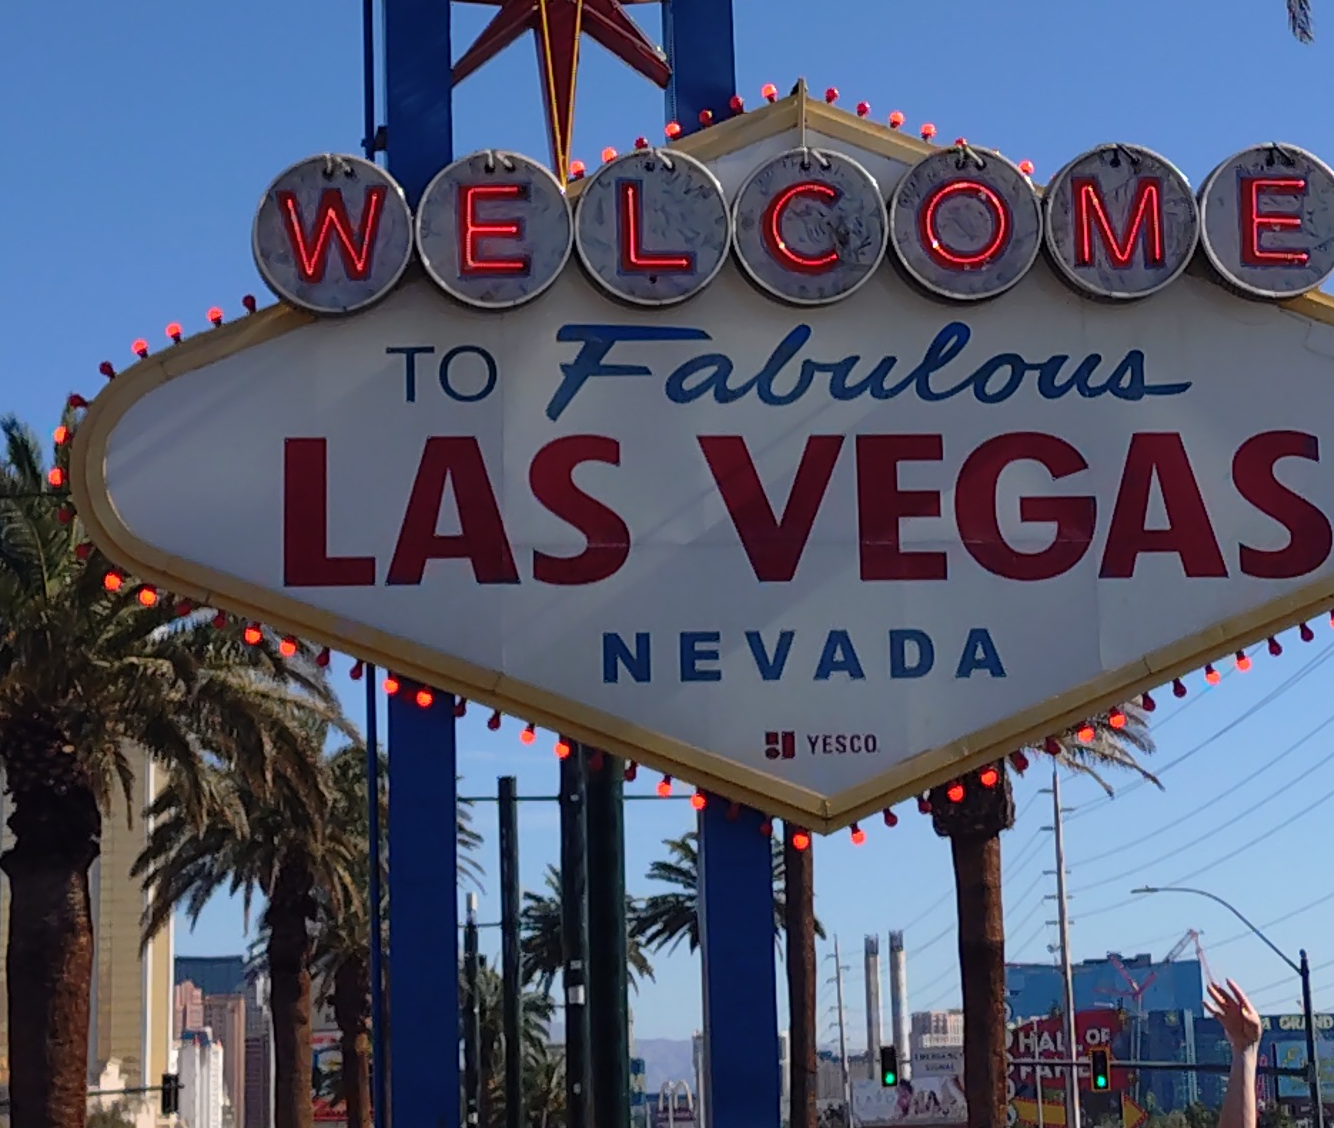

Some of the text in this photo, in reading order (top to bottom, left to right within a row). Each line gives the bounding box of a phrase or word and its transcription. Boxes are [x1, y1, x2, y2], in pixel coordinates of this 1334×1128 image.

[275, 176, 1310, 284] WELCOME
[385, 321, 1192, 422] TO Fabulous
[283, 429, 1334, 587] LAS VEGAS
[602, 627, 1007, 683] NEVADA
[807, 734, 877, 754] YESCO
